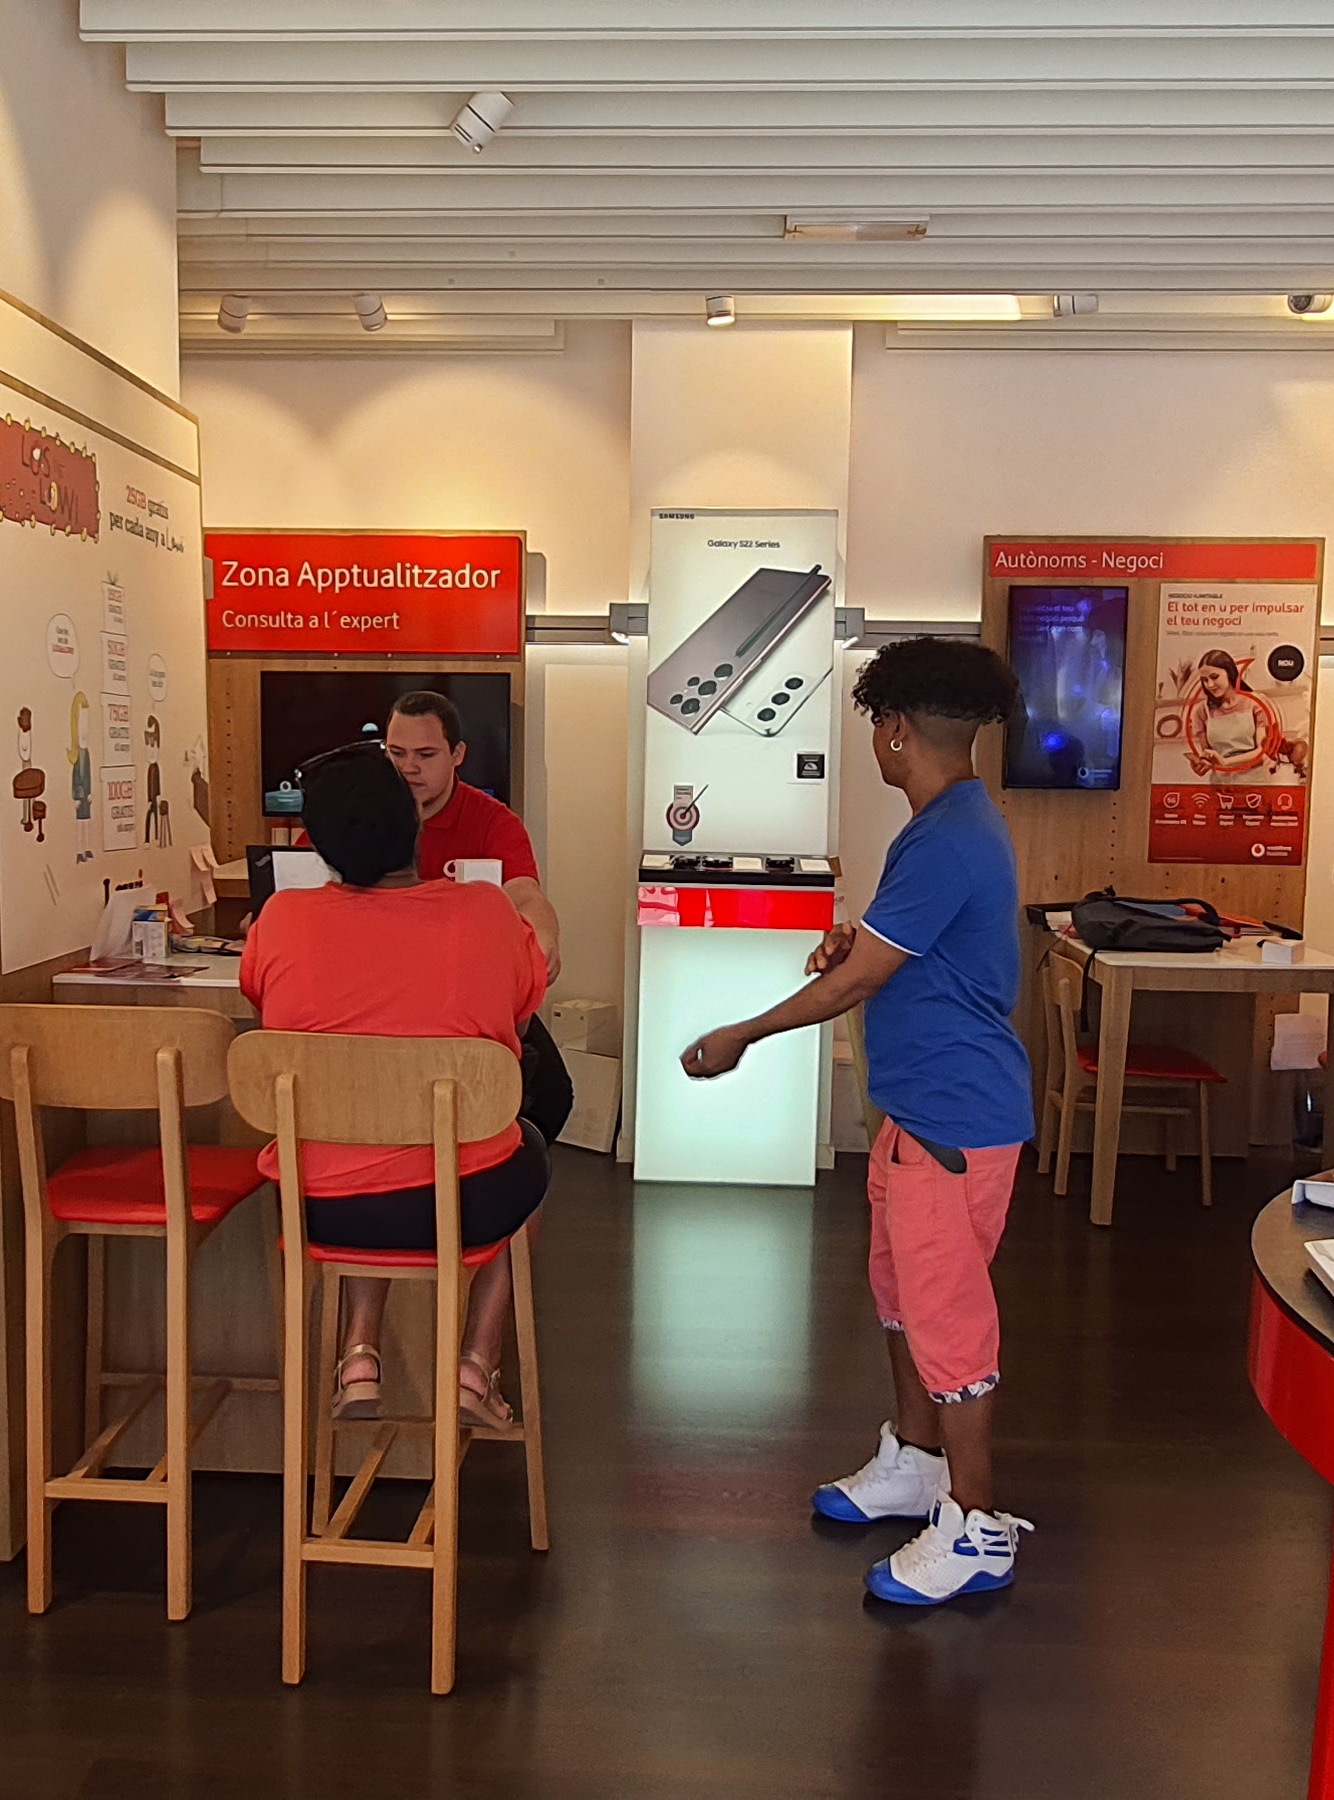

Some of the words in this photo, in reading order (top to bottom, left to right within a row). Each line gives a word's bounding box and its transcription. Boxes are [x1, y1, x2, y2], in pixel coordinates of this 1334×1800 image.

[707, 539, 739, 549] Galaxy
[739, 540, 754, 548] S22
[755, 540, 781, 549] Series
[995, 550, 1087, 569] Autònoms
[1101, 551, 1165, 573] Negoci
[221, 561, 290, 587] Zona
[297, 561, 501, 593] Apptualitzador
[1182, 602, 1199, 613] tot
[1201, 603, 1216, 613] en
[1229, 604, 1250, 616] per
[1252, 602, 1305, 616] impulsar
[222, 610, 304, 630] Consulta
[308, 615, 320, 629] a
[1180, 616, 1200, 626] teu
[1202, 616, 1242, 629] negoci
